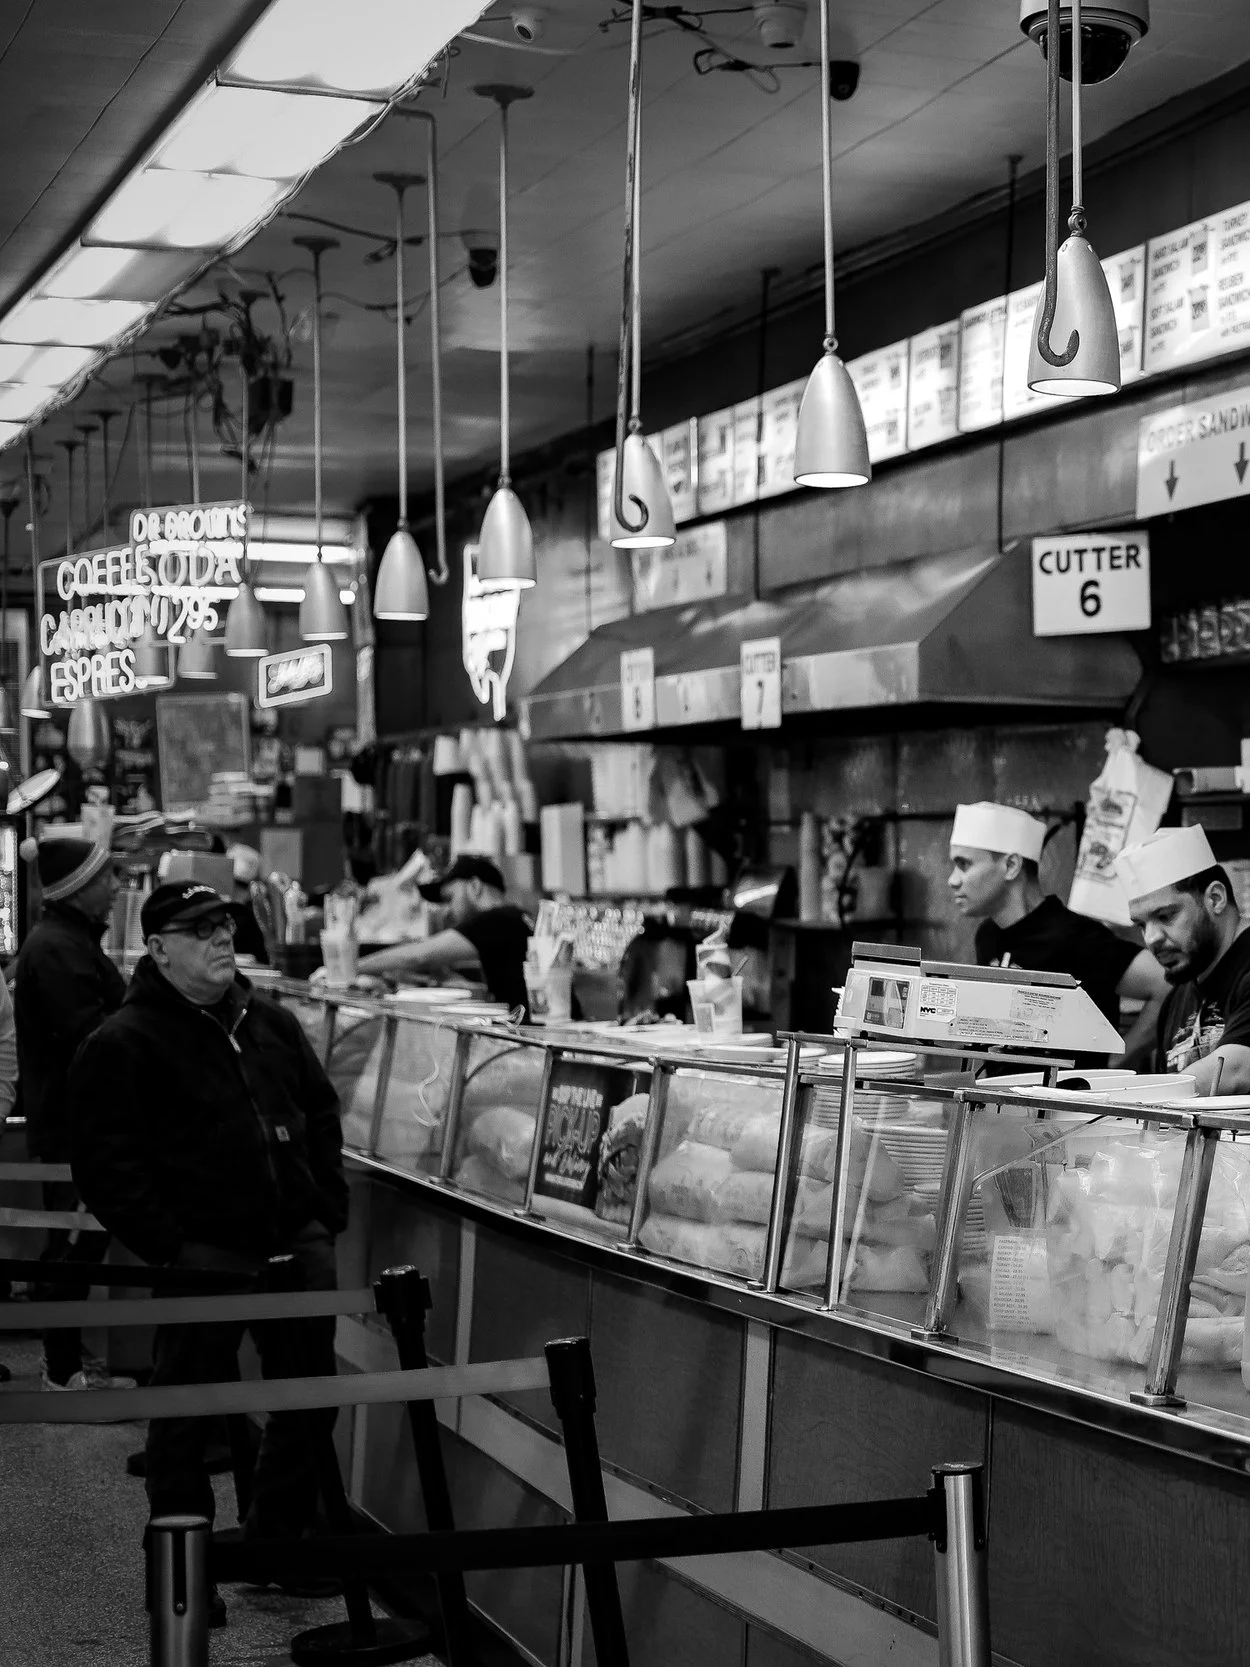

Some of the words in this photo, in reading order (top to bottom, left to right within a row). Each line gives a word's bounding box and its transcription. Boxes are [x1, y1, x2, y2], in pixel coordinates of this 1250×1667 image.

[57, 544, 150, 600] COFFEE
[1038, 541, 1143, 577] CUTTER
[1079, 579, 1102, 619] 6
[51, 649, 146, 704] ESPRES
[920, 1006, 936, 1014] NYC
